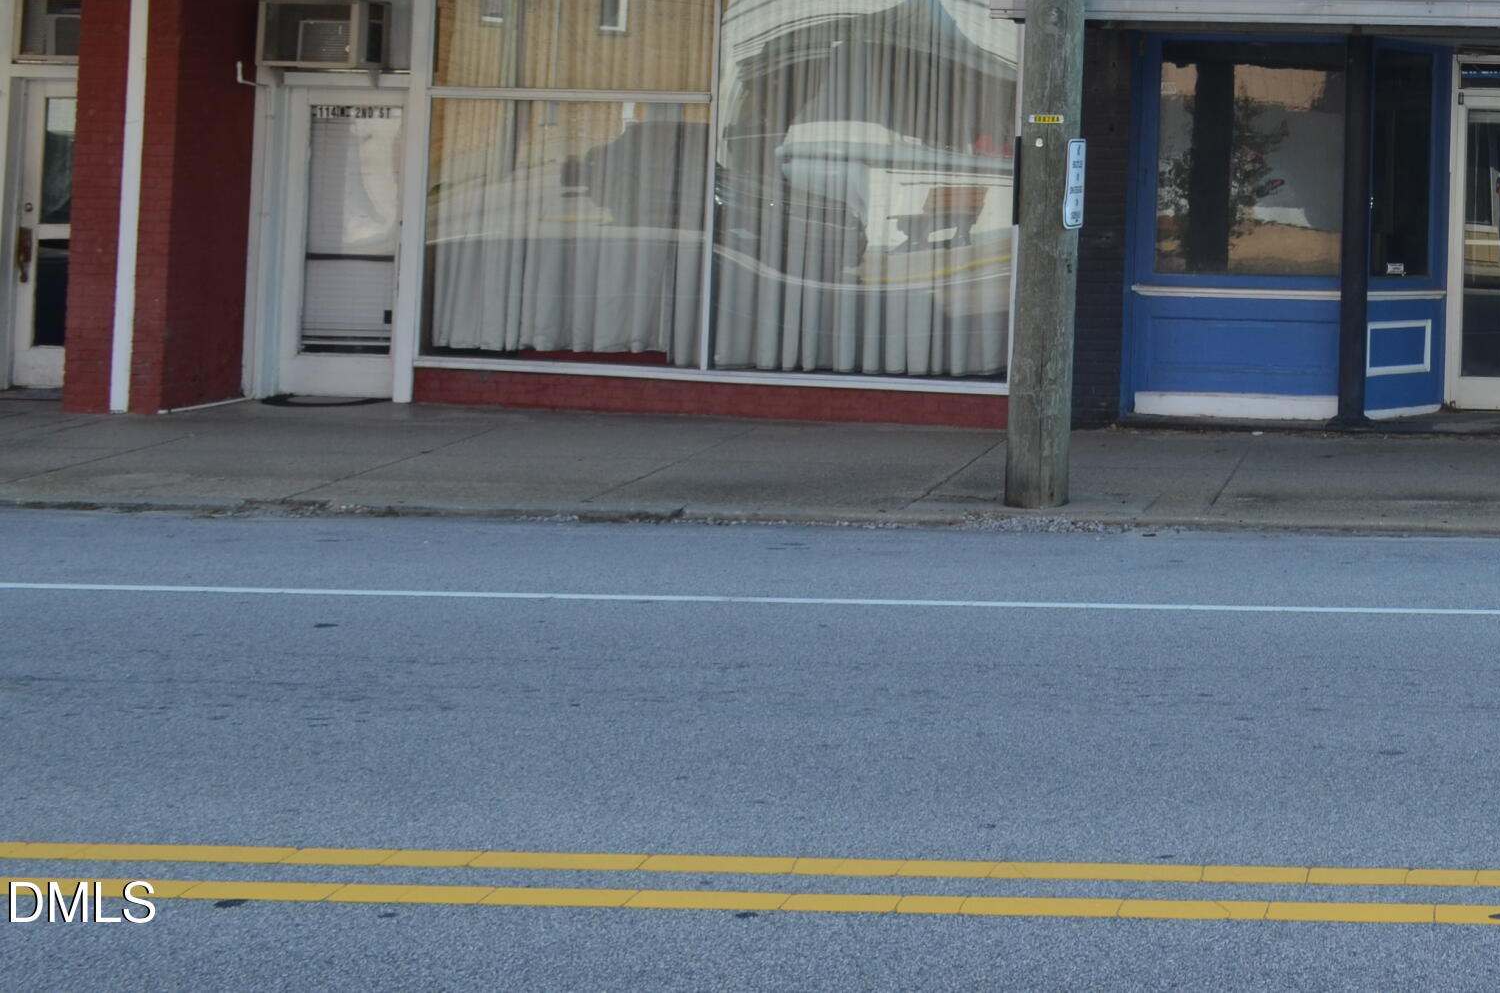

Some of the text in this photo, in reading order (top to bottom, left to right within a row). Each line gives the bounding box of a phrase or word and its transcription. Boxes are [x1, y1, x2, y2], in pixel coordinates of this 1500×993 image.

[319, 107, 337, 118] 114
[355, 107, 373, 118] 2ND
[379, 107, 391, 118] ST
